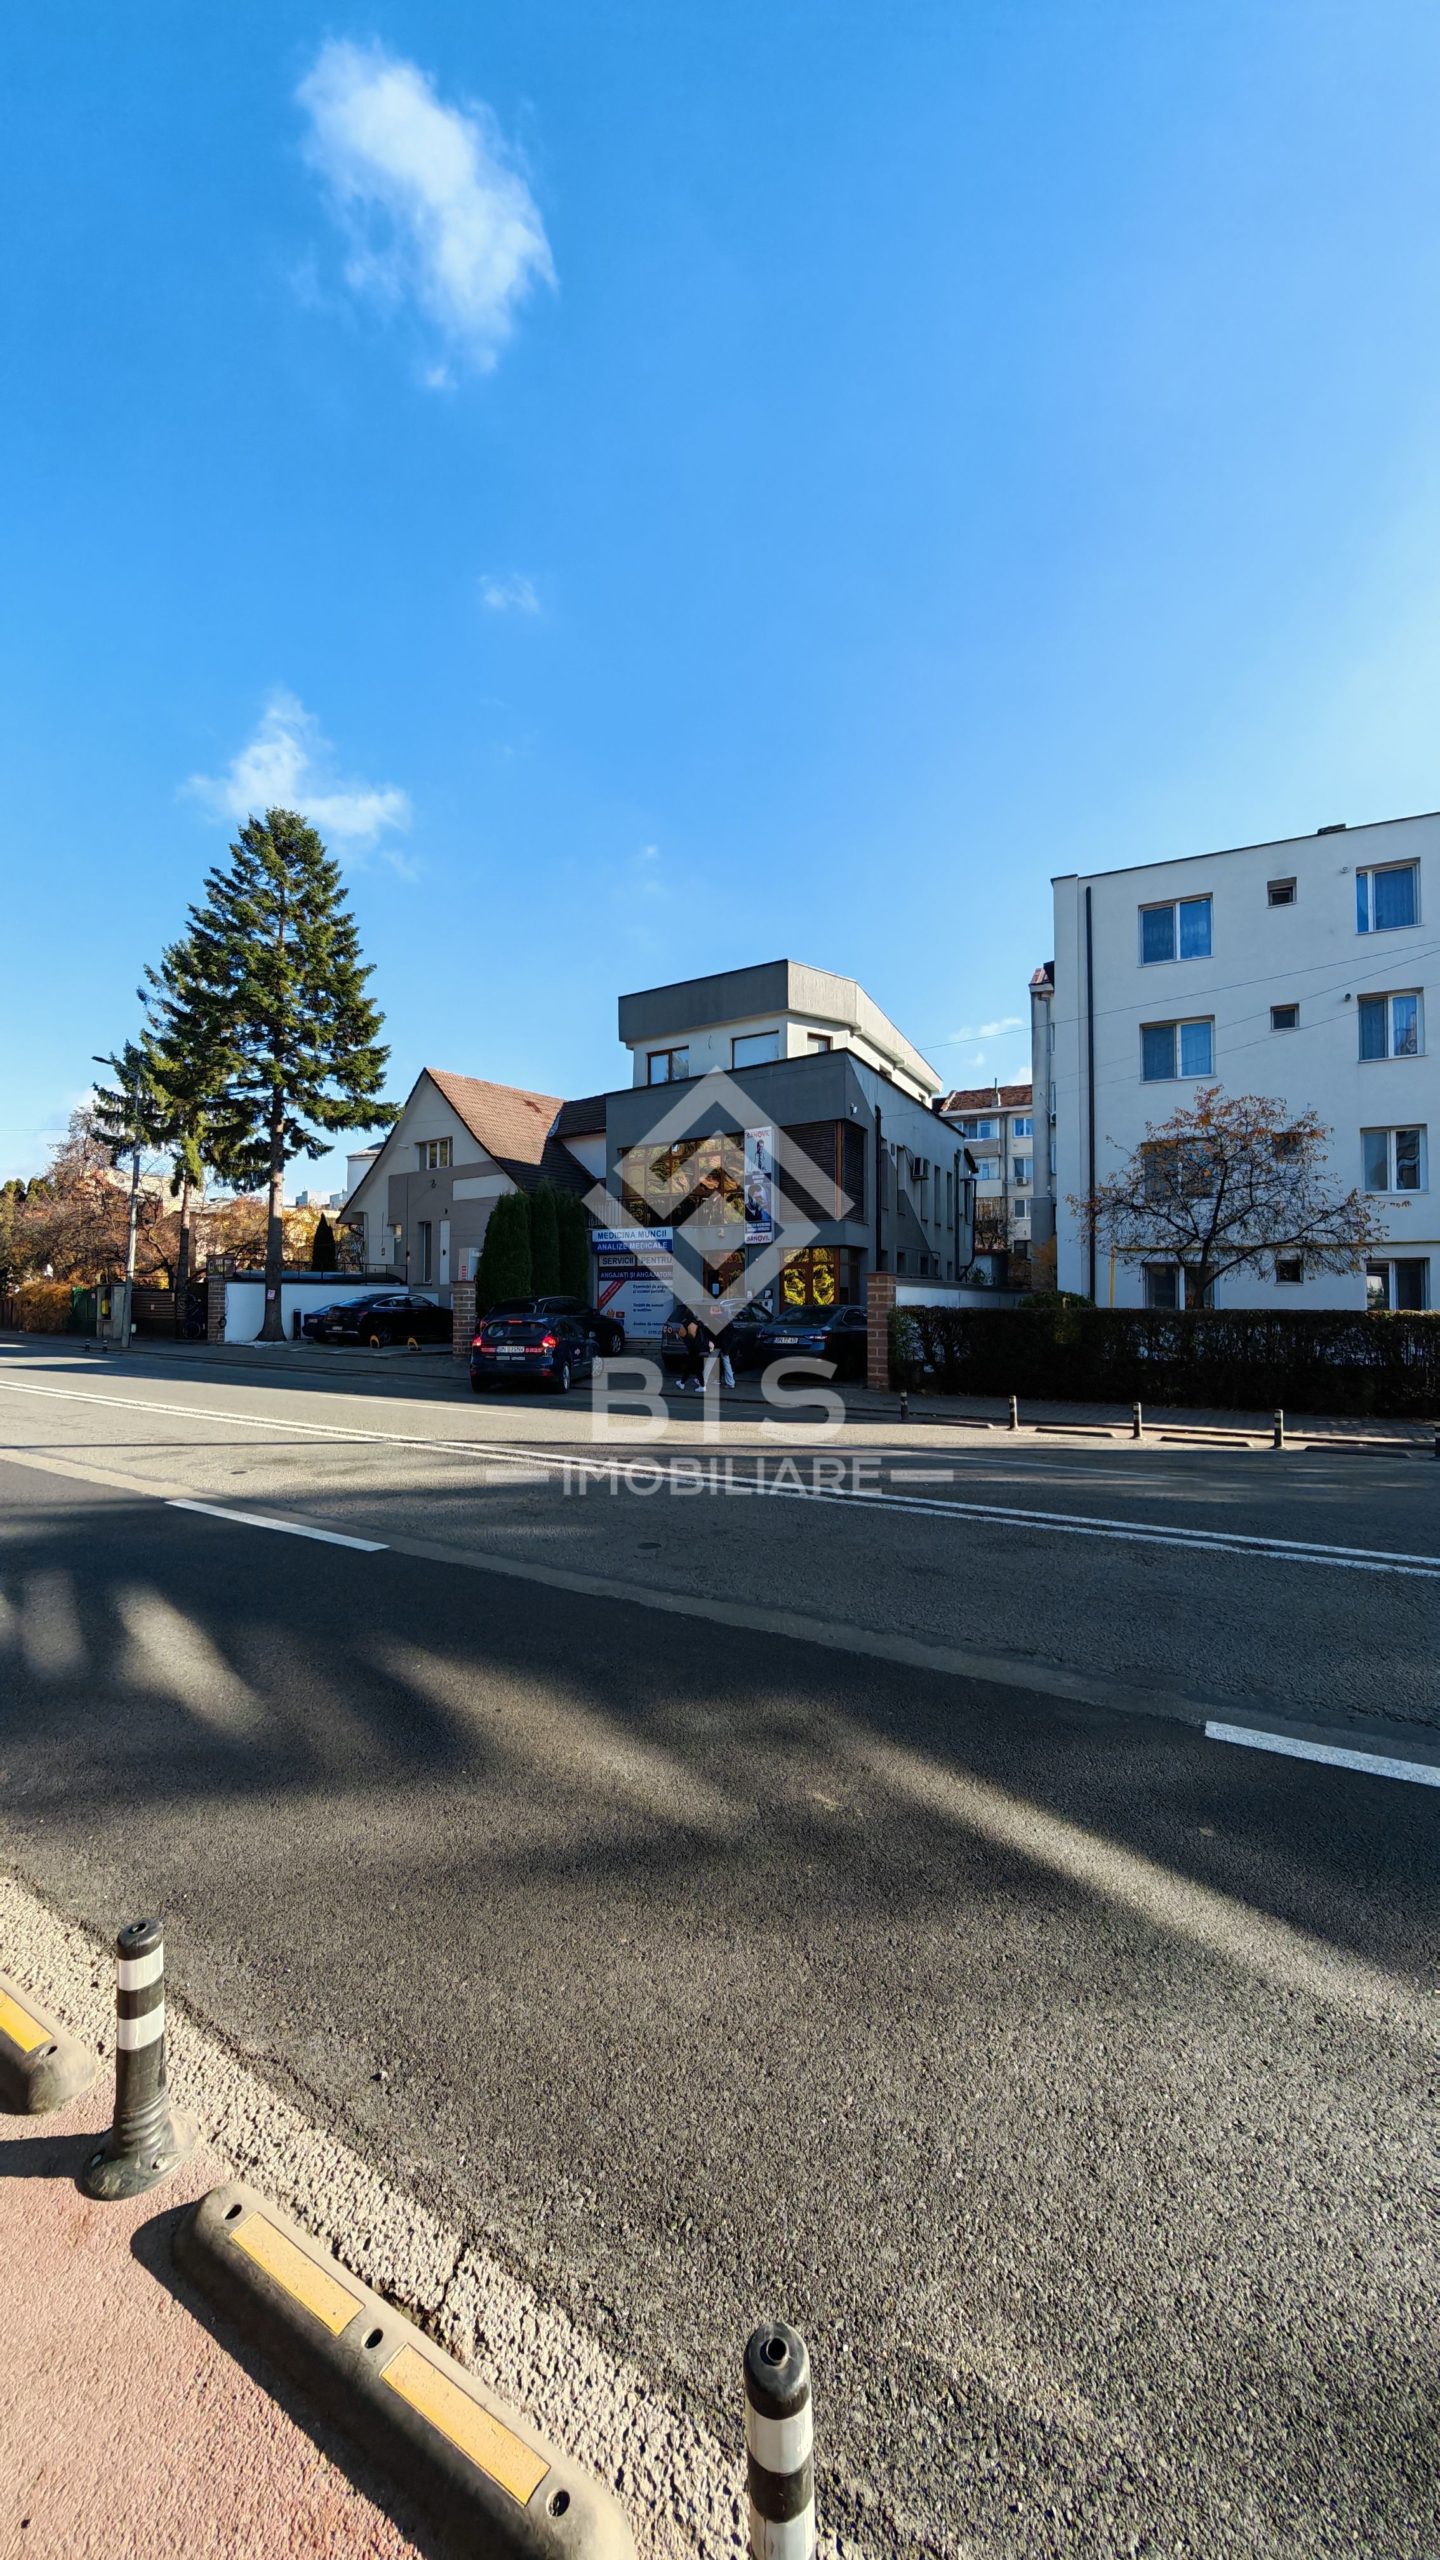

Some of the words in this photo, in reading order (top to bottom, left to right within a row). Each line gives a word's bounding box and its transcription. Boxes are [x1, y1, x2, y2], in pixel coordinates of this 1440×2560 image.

[597, 1231, 635, 1239] MEDICINA
[638, 1230, 667, 1238] MUNCII
[597, 1242, 628, 1251] ANALIZE
[629, 1241, 668, 1249] MEDICALE
[602, 1256, 634, 1265] SERVICII
[640, 1256, 673, 1264] PENTRU
